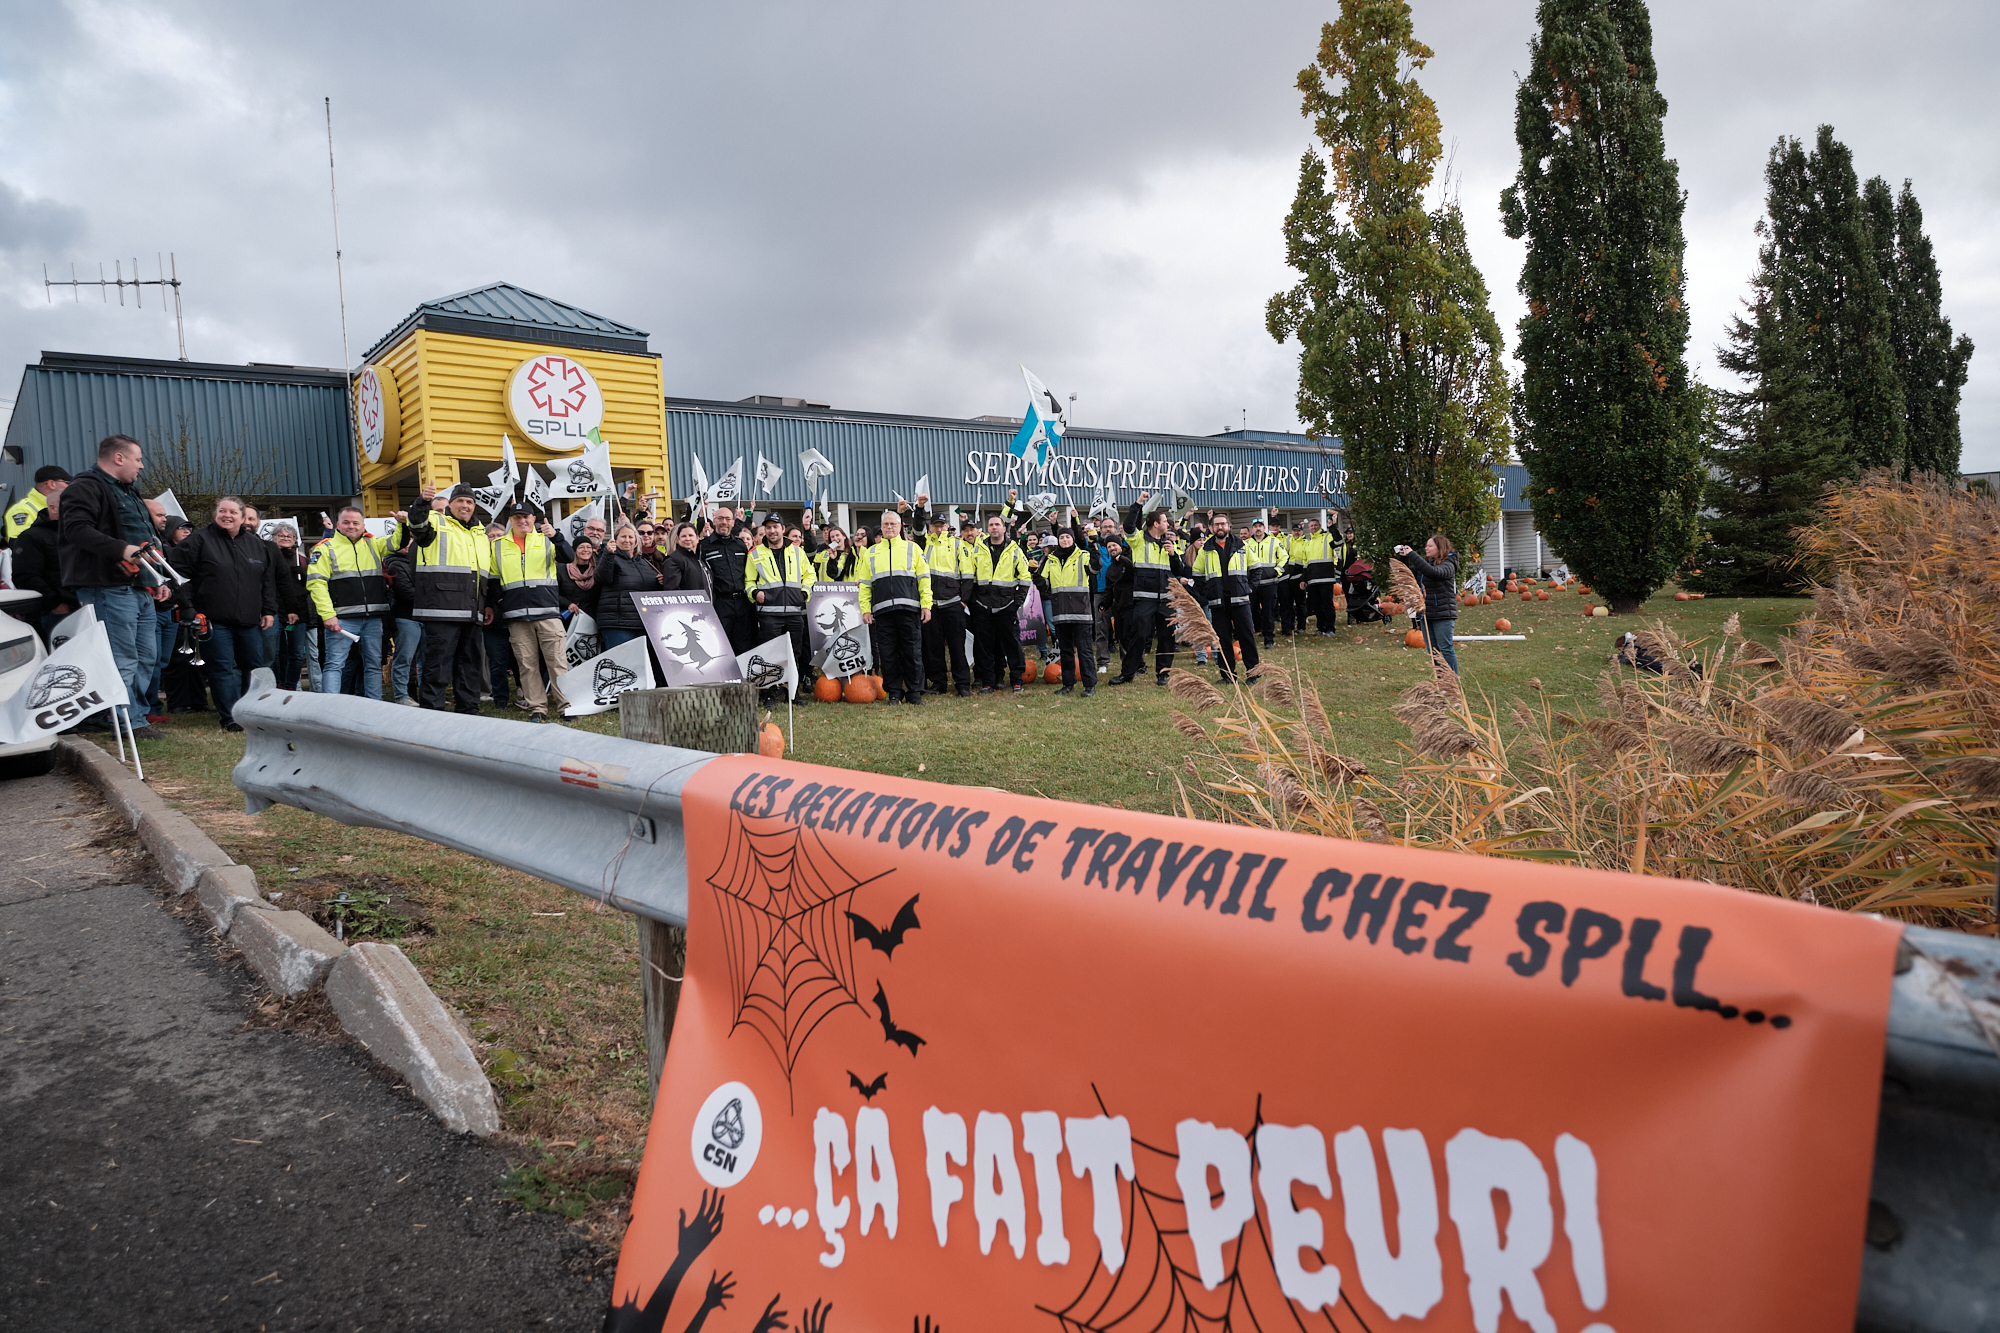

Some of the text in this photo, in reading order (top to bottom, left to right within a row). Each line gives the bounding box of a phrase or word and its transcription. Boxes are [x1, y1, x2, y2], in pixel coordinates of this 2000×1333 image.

[527, 419, 587, 438] SPLL
[365, 429, 383, 454] SPLL
[964, 450, 1099, 488] SERVICES
[1104, 450, 1300, 494] PRÉHOSPITALIERS
[566, 483, 598, 494] CSN
[474, 490, 499, 510] CSN
[640, 595, 664, 606] GÉRER
[663, 596, 679, 605] PAR
[677, 595, 688, 604] LA
[1019, 629, 1037, 641] SPECT
[838, 655, 866, 673] CSN
[35, 690, 105, 730] CSN
[729, 772, 1793, 1030] LES RELATIONS DE TRAVAIL CHEZ SPLL...
[702, 1142, 738, 1174] CSN
[758, 1104, 1617, 1333] ...ÇA FAIT PEUR!
